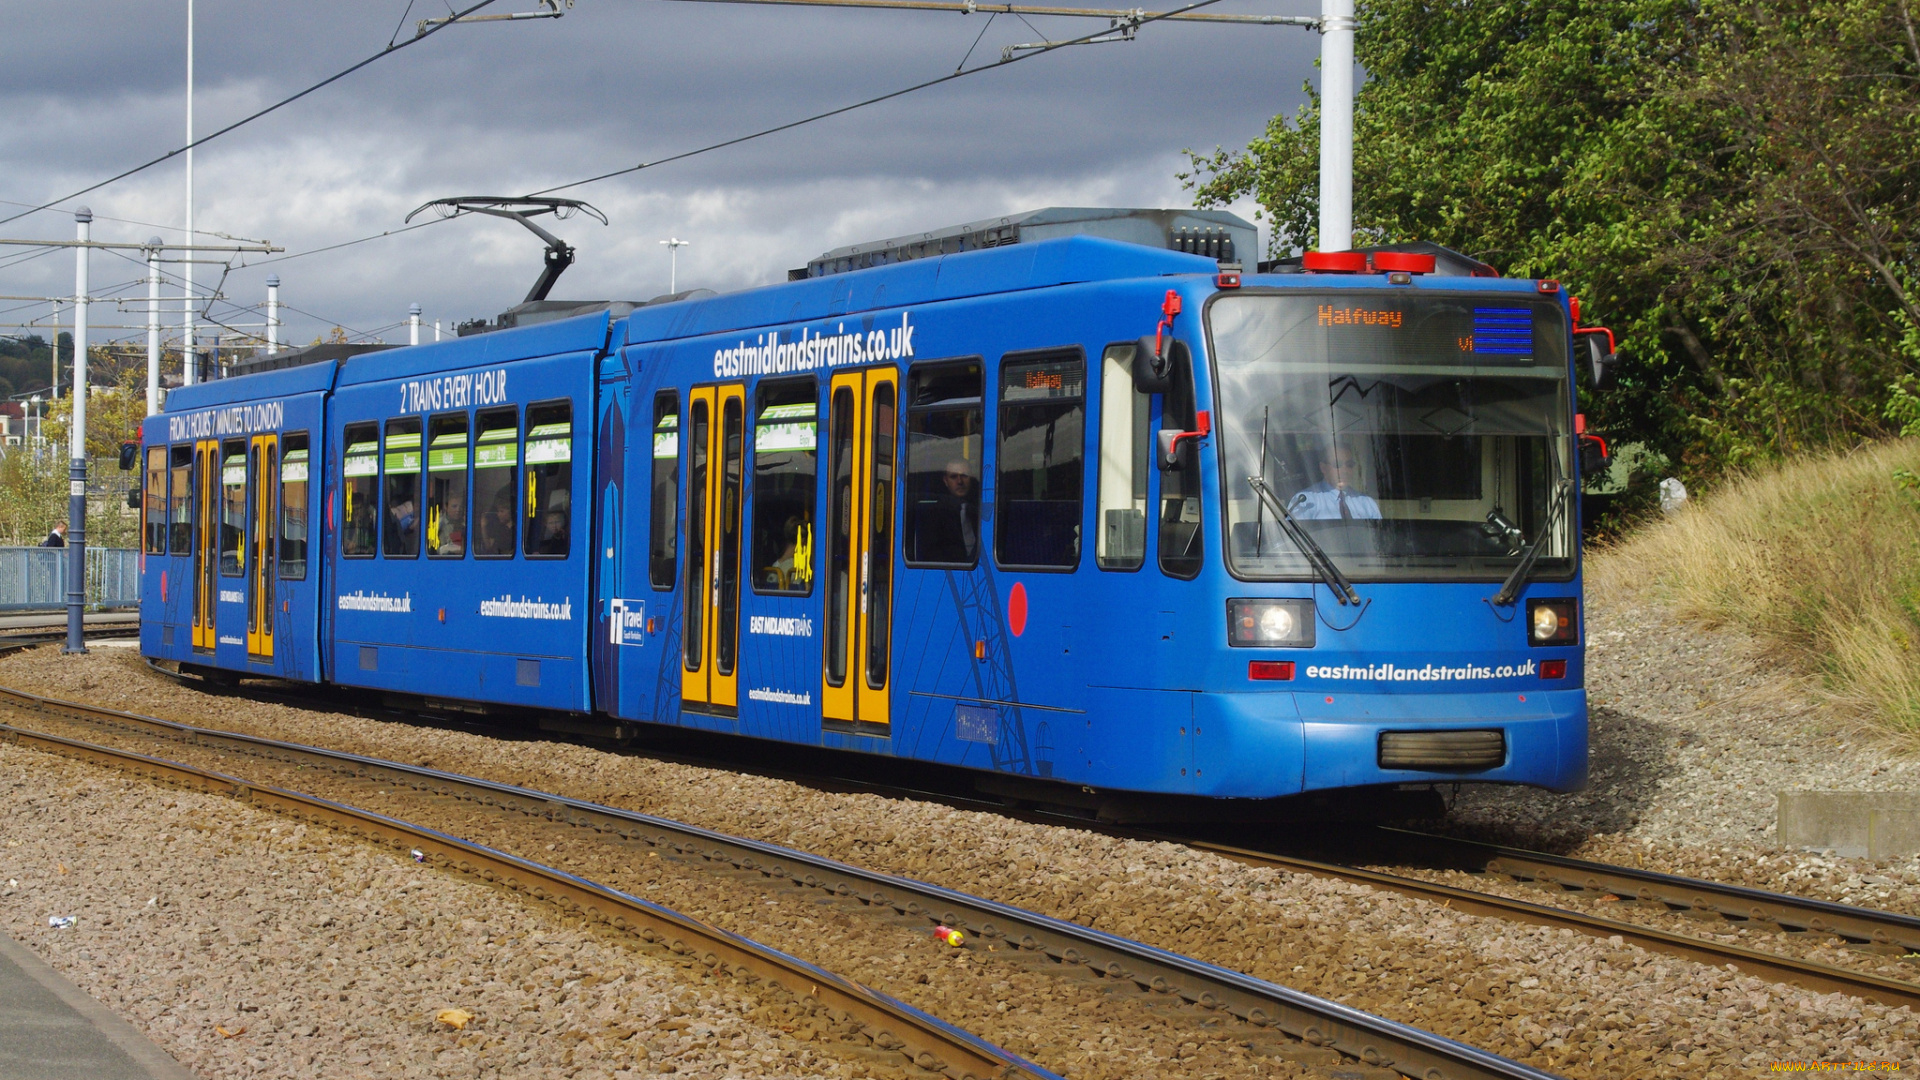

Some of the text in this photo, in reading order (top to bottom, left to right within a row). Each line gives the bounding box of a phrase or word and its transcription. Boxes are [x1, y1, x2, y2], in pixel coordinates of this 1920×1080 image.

[1318, 304, 1403, 328] Halfway
[713, 311, 915, 378] eastmidlandstrains.co.uk
[400, 368, 507, 414] 2 TRAINS EVERY HOUR
[1026, 371, 1062, 389] Halfway
[170, 416, 185, 441] FROM
[191, 410, 211, 439] HOURS
[212, 410, 217, 436] 7
[217, 406, 243, 435] MINUTES
[244, 405, 253, 433] TO
[254, 400, 284, 432] LONDON
[338, 589, 411, 613] eastmidlandstrains.co.uk
[480, 594, 572, 620] eastmidlandstrains.co.uk
[623, 606, 643, 628] Travel
[750, 616, 764, 634] EAST
[1305, 658, 1536, 682] eastmidlandstrains.co.uk
[748, 687, 811, 705] eastmidlandstrains.co.uk
